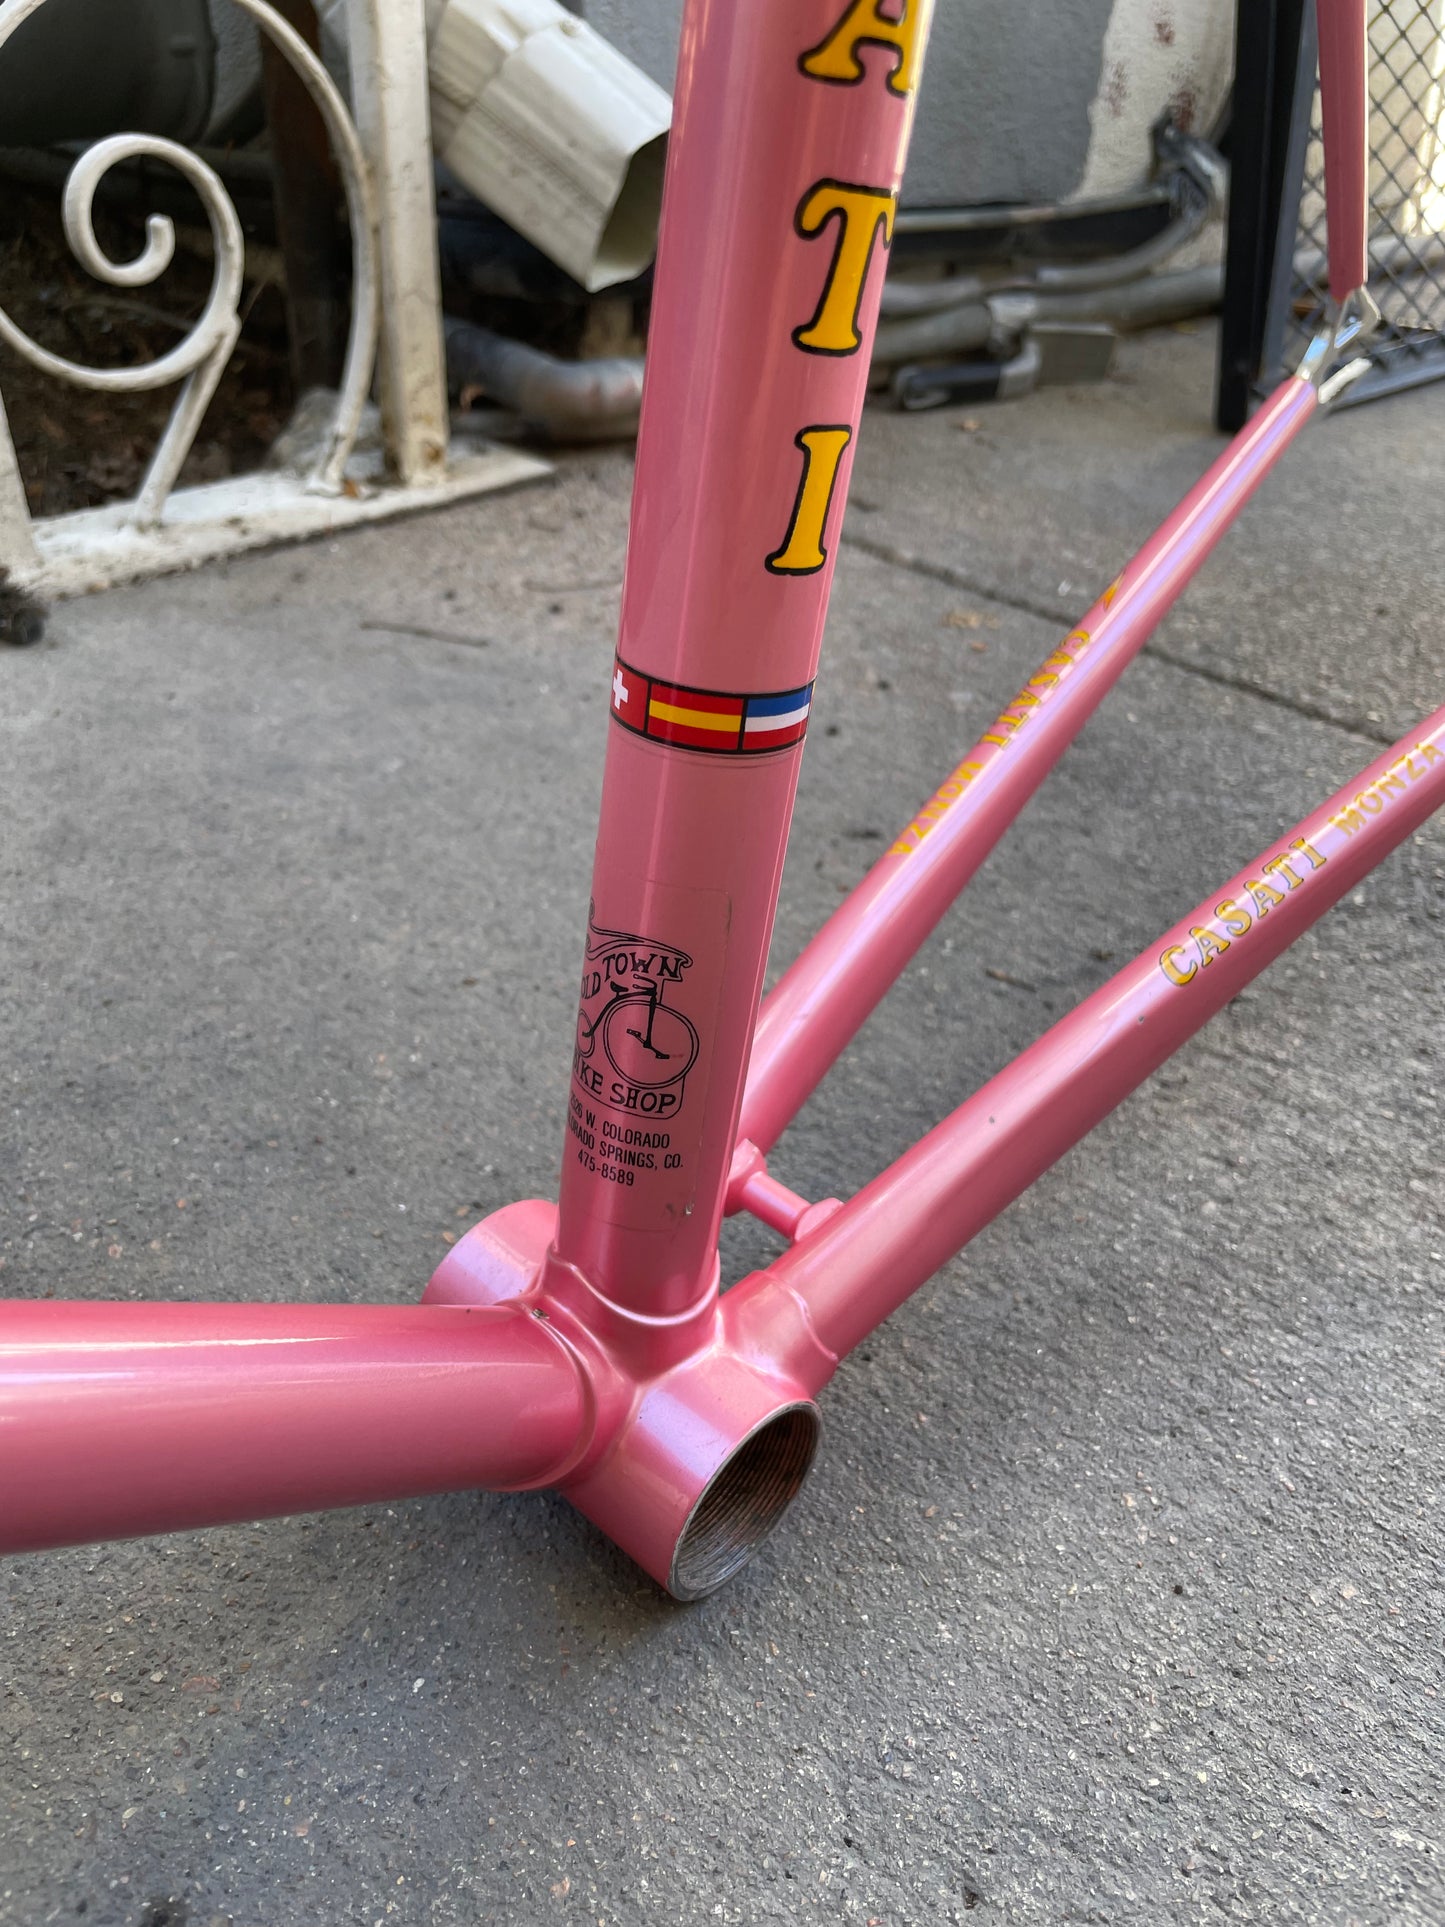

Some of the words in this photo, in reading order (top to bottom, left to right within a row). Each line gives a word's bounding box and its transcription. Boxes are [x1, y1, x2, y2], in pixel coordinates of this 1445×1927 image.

[979, 629, 1091, 751] CASATI
[1159, 837, 1327, 987] CASATI
[1328, 742, 1445, 838] MONZA
[580, 971, 601, 999] OLD
[602, 951, 683, 982] TOWN
[609, 1082, 677, 1114] SHOP
[585, 1109, 598, 1131] W.
[602, 1120, 670, 1149] COLORADO
[577, 1148, 635, 1187] 475-8589
[599, 1141, 658, 1171] SPRINGS,
[664, 1153, 684, 1169] CO.
